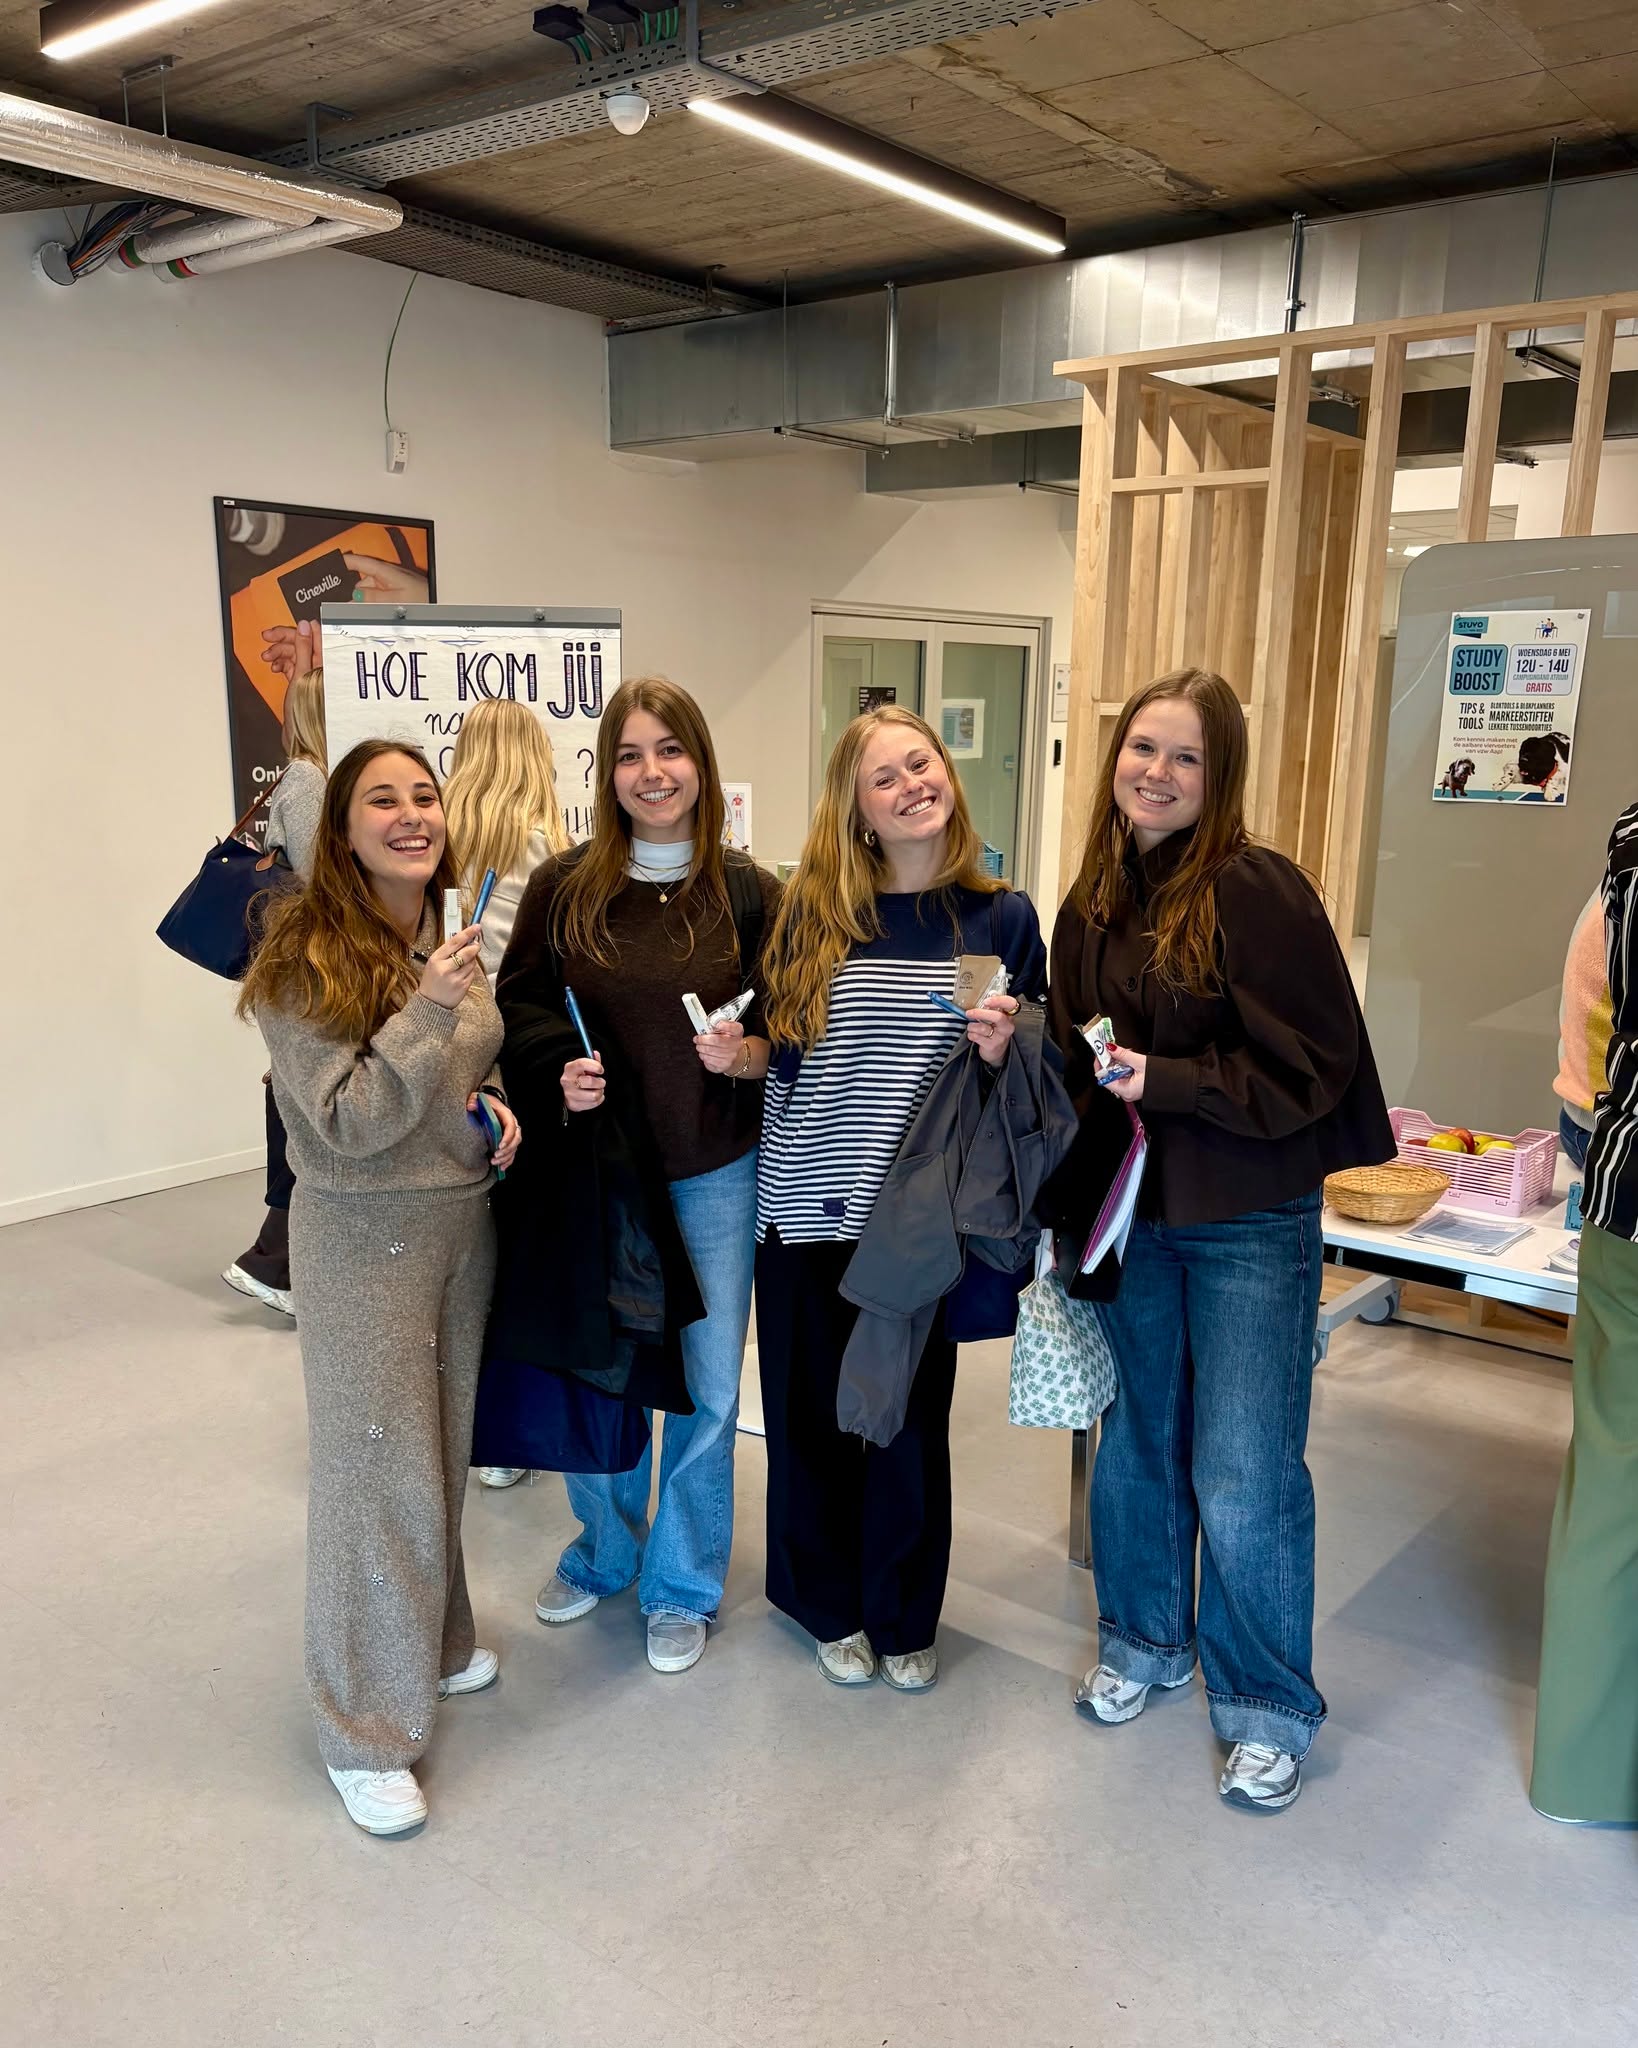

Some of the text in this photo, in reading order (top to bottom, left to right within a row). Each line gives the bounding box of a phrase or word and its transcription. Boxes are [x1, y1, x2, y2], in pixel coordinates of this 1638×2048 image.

[296, 574, 341, 603] Cineville
[1456, 649, 1503, 668] STUDY
[1517, 648, 1552, 656] WOENSDAG
[1558, 648, 1571, 656] MEI
[1516, 659, 1537, 673] 12U
[1548, 659, 1570, 673] 14U
[356, 651, 429, 700] HOE
[456, 651, 537, 702] KOM
[1453, 672, 1501, 691] BOOST
[1526, 682, 1553, 693] GRATIS
[1460, 702, 1485, 714] TIPS &
[1489, 710, 1554, 722] MARKEERSTIFTEN
[1458, 717, 1484, 730] TOOLS
